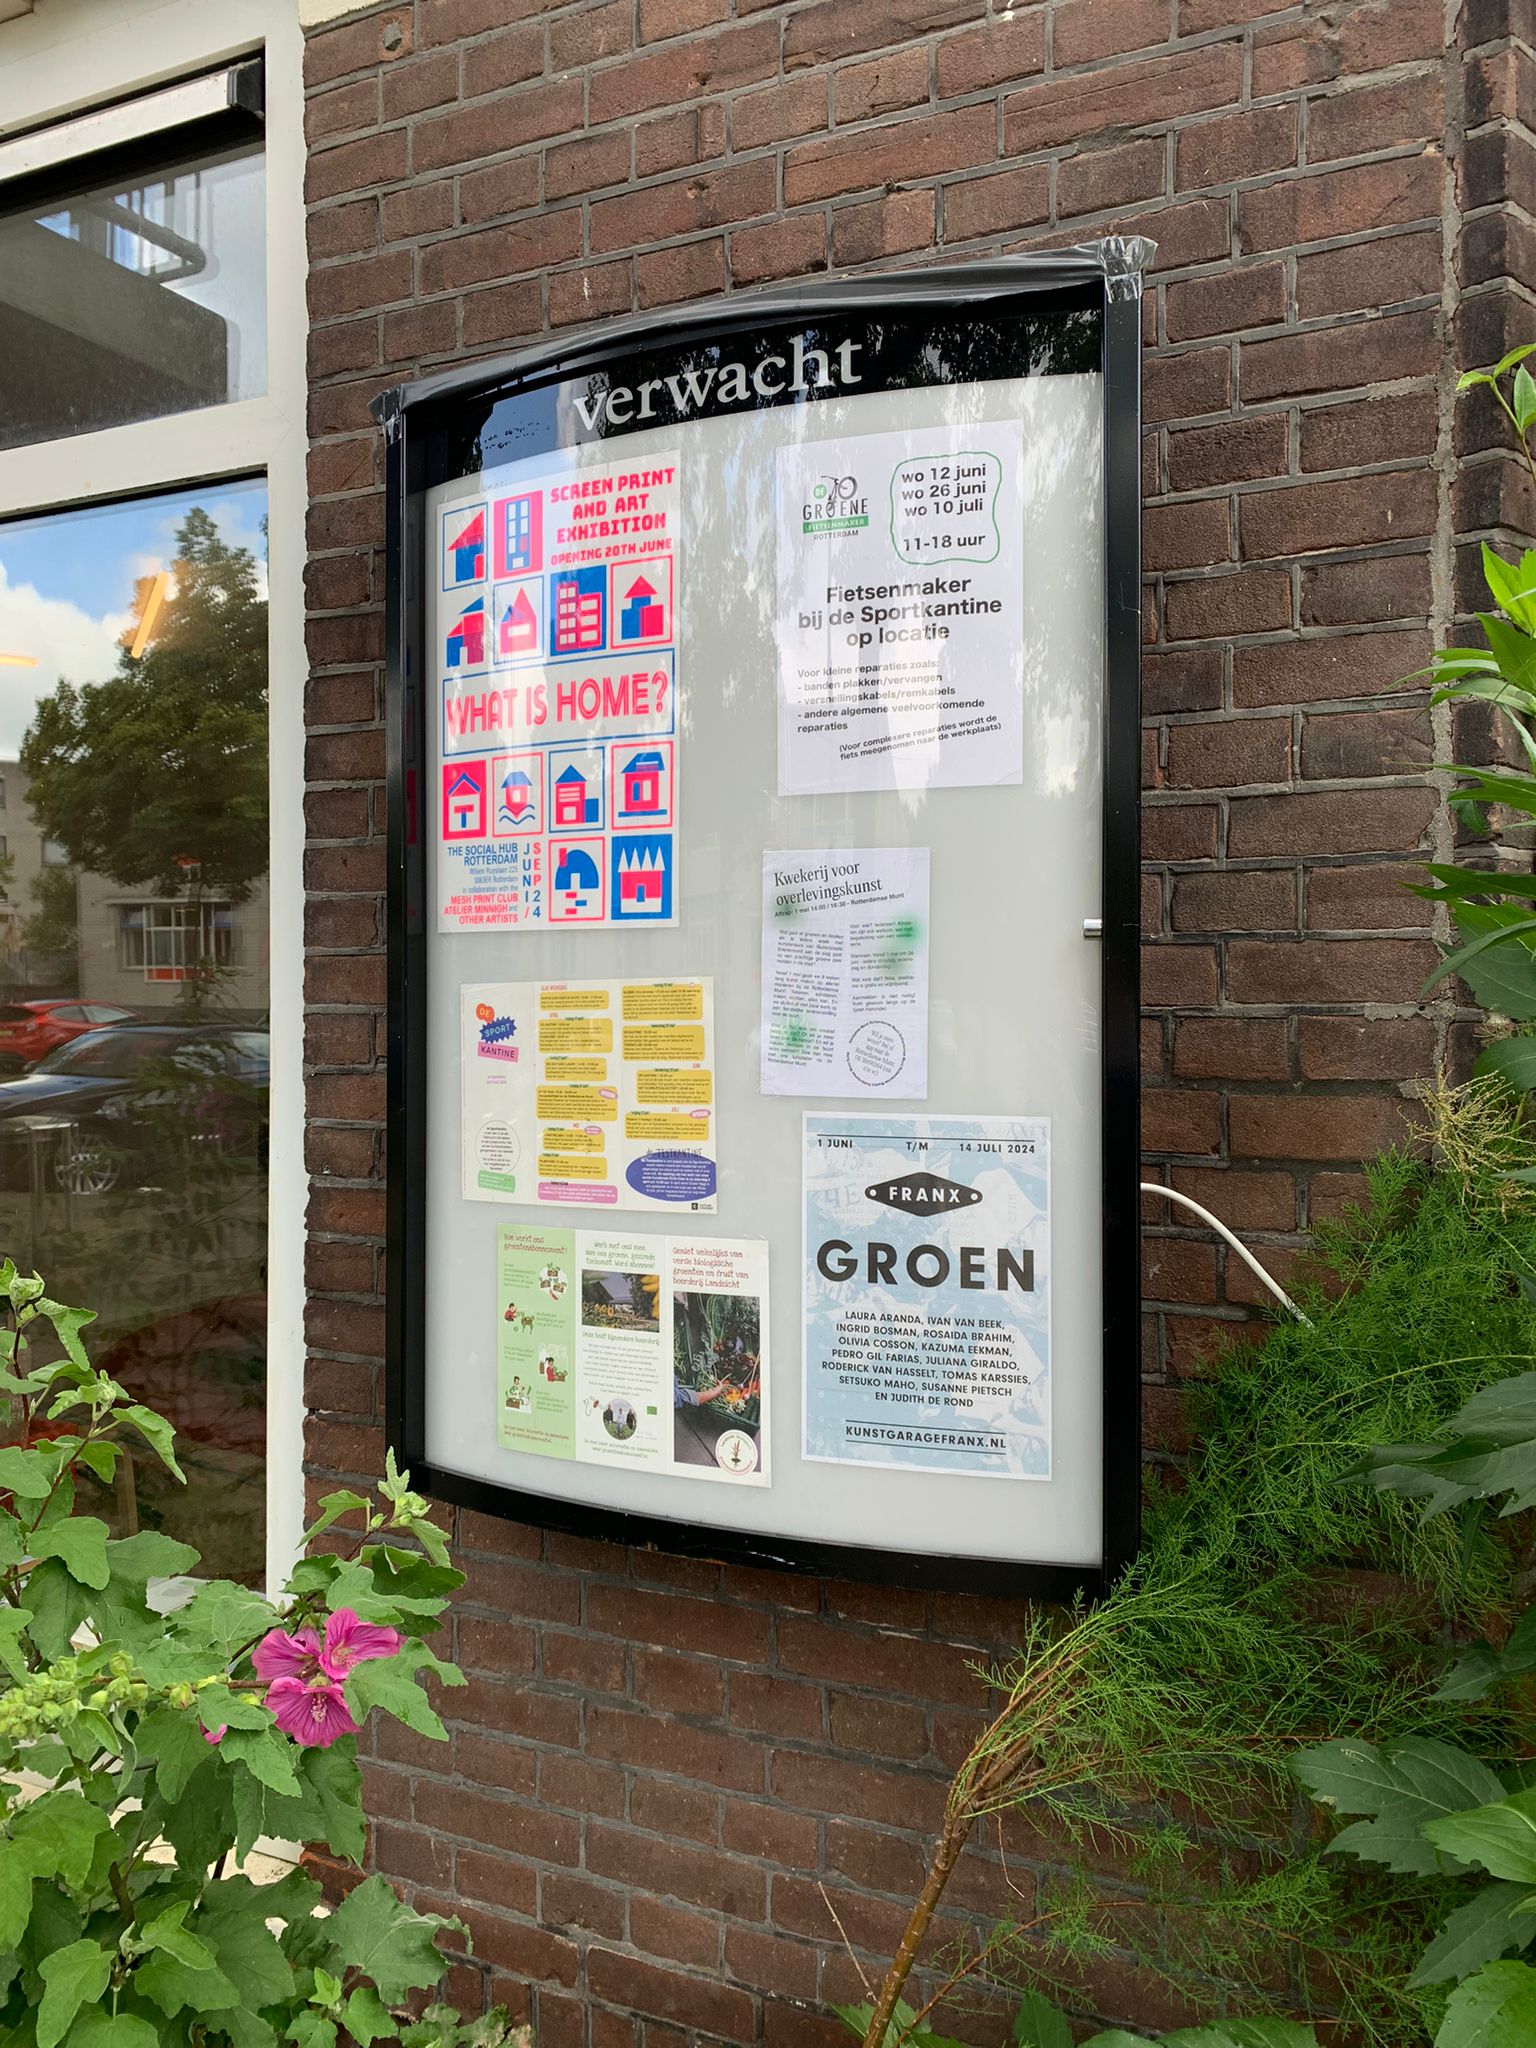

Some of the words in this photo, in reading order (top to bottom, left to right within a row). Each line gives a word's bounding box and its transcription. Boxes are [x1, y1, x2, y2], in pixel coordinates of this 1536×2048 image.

[572, 334, 862, 430] verwacht
[902, 472, 924, 483] wo
[931, 467, 950, 480] 12
[954, 464, 986, 481] juni
[551, 478, 612, 503] SCREEN
[618, 468, 675, 491] PRINT
[815, 488, 825, 496] DE
[902, 489, 923, 500] wo
[930, 484, 950, 497] 26
[954, 481, 986, 497] juni
[573, 504, 606, 520] AND
[615, 494, 649, 513] ART
[803, 498, 868, 520] GROENE
[905, 506, 927, 517] wo
[934, 501, 953, 514] 10
[957, 498, 983, 515] juli
[557, 513, 666, 543] EXHIBITION
[813, 530, 859, 539] ROTTERDAM
[551, 548, 602, 565] OPENING
[605, 543, 636, 557] 20TH
[639, 538, 672, 552] JUNE
[904, 535, 952, 551] 11-18
[958, 534, 985, 547] uur
[827, 578, 971, 603] Fietsenmaker
[799, 611, 822, 629] bij
[829, 609, 854, 626] de
[861, 598, 1002, 624] Sportkantine
[847, 632, 872, 648] op
[879, 624, 949, 643] locatie
[798, 669, 819, 678] Voor
[824, 667, 852, 676] kleine
[855, 662, 907, 674] reparaties
[804, 682, 840, 691] banden
[844, 674, 942, 689] plakken/vervangen
[446, 689, 517, 736] WHAT
[526, 685, 547, 725] IS
[557, 671, 668, 722] HOME?
[804, 710, 838, 719] andere
[841, 707, 888, 718] algemene
[892, 699, 984, 712] veelvoorkomende
[798, 722, 848, 734] reparaties
[839, 742, 860, 752] (Voor
[863, 732, 910, 748] complexere
[913, 723, 956, 737] reparaties
[959, 718, 984, 727] wordt
[986, 715, 997, 723] de
[840, 752, 858, 760] fiets
[860, 740, 915, 757] meegenomen
[917, 737, 935, 745] naar
[938, 733, 949, 741] de
[951, 722, 1001, 738] werkplaats)
[448, 847, 463, 856] THE
[465, 845, 496, 855] SOCIAL
[499, 843, 517, 853] HUB
[464, 854, 517, 866] ROTTERDAM
[774, 866, 828, 886] Kwekerij
[832, 863, 860, 876] voor
[451, 896, 471, 905] MESH
[473, 894, 494, 904] PRINT
[497, 893, 518, 902] CLUB
[776, 878, 882, 906] overlevingskunst
[851, 895, 888, 906] Rotterdamse
[889, 892, 904, 900] Munt
[444, 906, 472, 915] ATELIER
[475, 905, 508, 913] MINNIGH
[459, 916, 483, 925] OTHER
[486, 914, 518, 923] ARTISTS
[480, 1009, 490, 1017] DE
[485, 1023, 510, 1038] SPORT
[481, 1046, 515, 1059] KANTINE
[828, 1139, 853, 1149] JUNI
[906, 1141, 928, 1151] T/M
[960, 1144, 971, 1152] 14
[977, 1144, 1002, 1153] JULI
[1008, 1145, 1035, 1153] 2024
[889, 1186, 960, 1203] FRANX
[673, 1247, 694, 1256] Geniet
[673, 1257, 693, 1265] verse
[694, 1258, 733, 1269] biologische
[817, 1239, 1034, 1292] GROEN
[673, 1268, 704, 1277] groenten
[716, 1270, 733, 1278] fruit
[673, 1277, 703, 1287] boerderij
[705, 1279, 740, 1288] Landzicht
[845, 1311, 876, 1321] LAURA
[880, 1314, 923, 1325] ARANDA,
[928, 1316, 950, 1326] IVAN
[955, 1318, 975, 1328] VAN
[979, 1319, 1004, 1330] BEEK,
[836, 1324, 870, 1334] INGRID
[874, 1327, 919, 1338] BOSMAN,
[924, 1330, 967, 1340] ROSAIDA
[972, 1333, 1014, 1343] BRAHIM,
[839, 1337, 869, 1347] OLIVIA
[873, 1339, 917, 1351] COSSON,
[922, 1343, 964, 1353] KAZUMA
[968, 1346, 1012, 1357] EEKMAN,
[832, 1349, 863, 1359] PEDRO
[867, 1352, 882, 1361] GIL
[886, 1353, 922, 1364] FARIAS,
[926, 1356, 967, 1367] JULIANA
[971, 1359, 1019, 1371] GIRALDO,
[822, 1362, 869, 1373] RODERICK
[872, 1365, 892, 1374] VAN
[896, 1368, 938, 1379] HASSELT,
[942, 1371, 977, 1381] TOMAS
[981, 1373, 1031, 1385] KARSSIES,
[839, 1376, 880, 1387] SETSUKO
[884, 1379, 918, 1391] MAHO,
[922, 1383, 967, 1393] SUSANNE
[972, 1386, 1012, 1396] PIETSCH
[875, 1392, 887, 1400] EN
[892, 1393, 924, 1403] JUDITH
[929, 1396, 940, 1404] DE
[944, 1398, 973, 1407] ROND
[846, 1426, 1006, 1448] KUNSTGARAGEFRANX.NL
